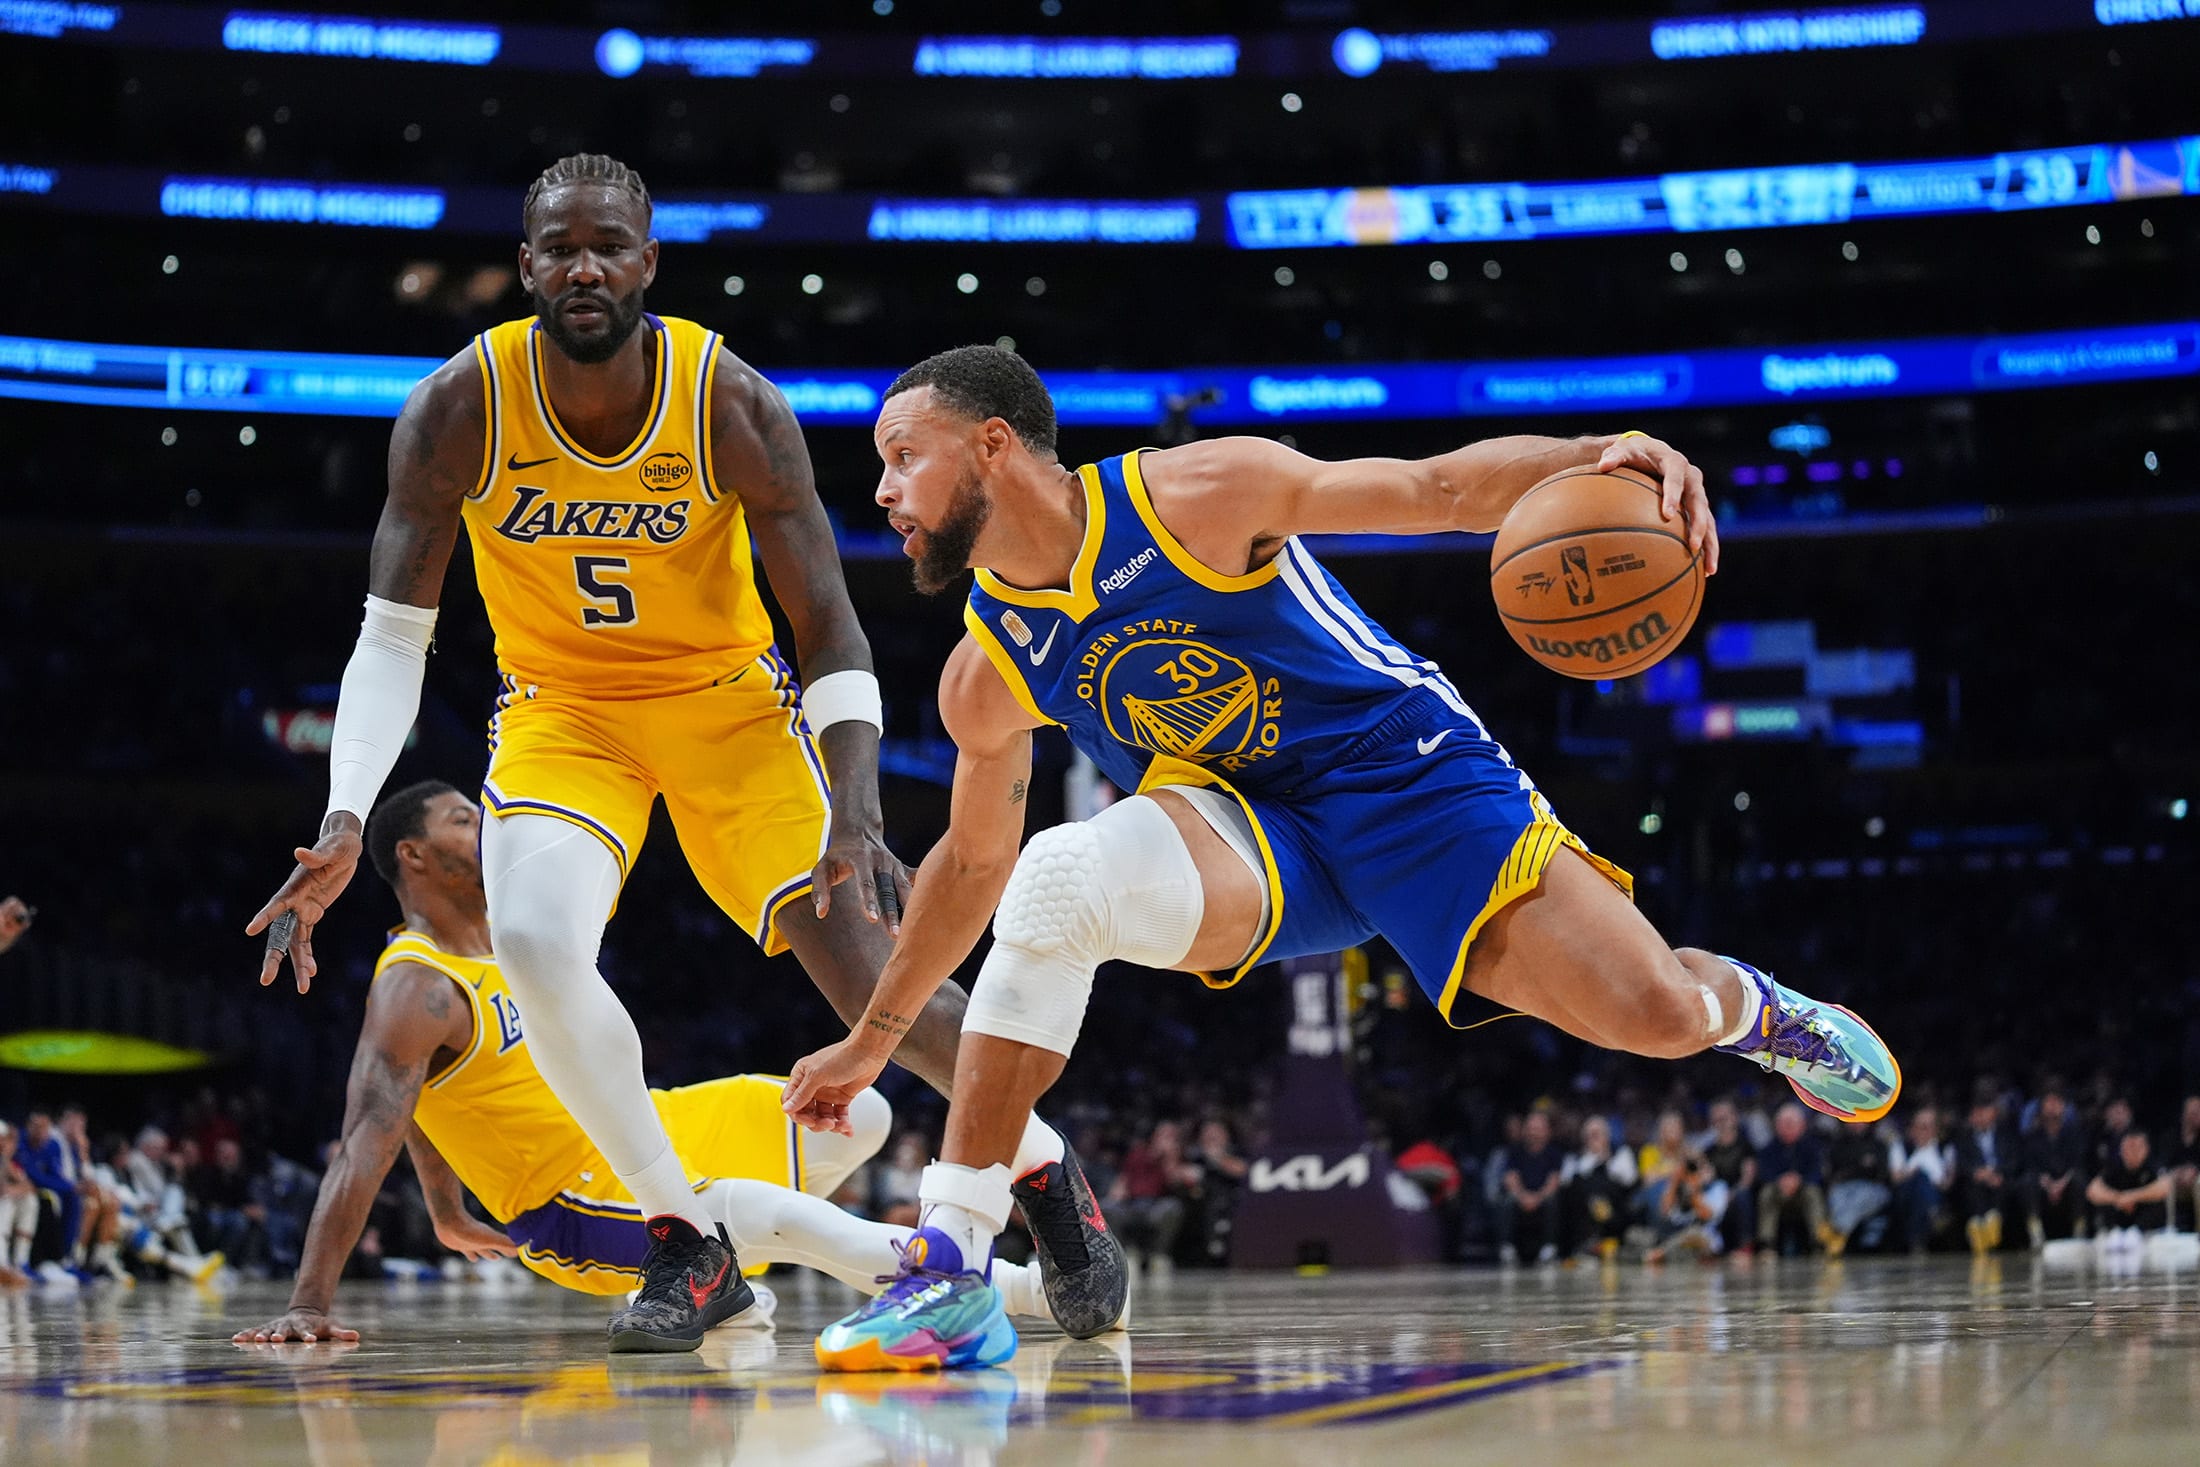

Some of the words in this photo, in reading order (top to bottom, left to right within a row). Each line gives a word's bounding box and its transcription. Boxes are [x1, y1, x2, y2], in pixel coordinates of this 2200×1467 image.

[644, 463, 689, 480] bibigo
[493, 486, 691, 543] LAKERS
[573, 556, 639, 630] 5
[1099, 547, 1158, 595] Rakuten
[1526, 610, 1671, 663] Wilson
[1076, 632, 1120, 710] OLDEN
[1153, 648, 1219, 694] 30
